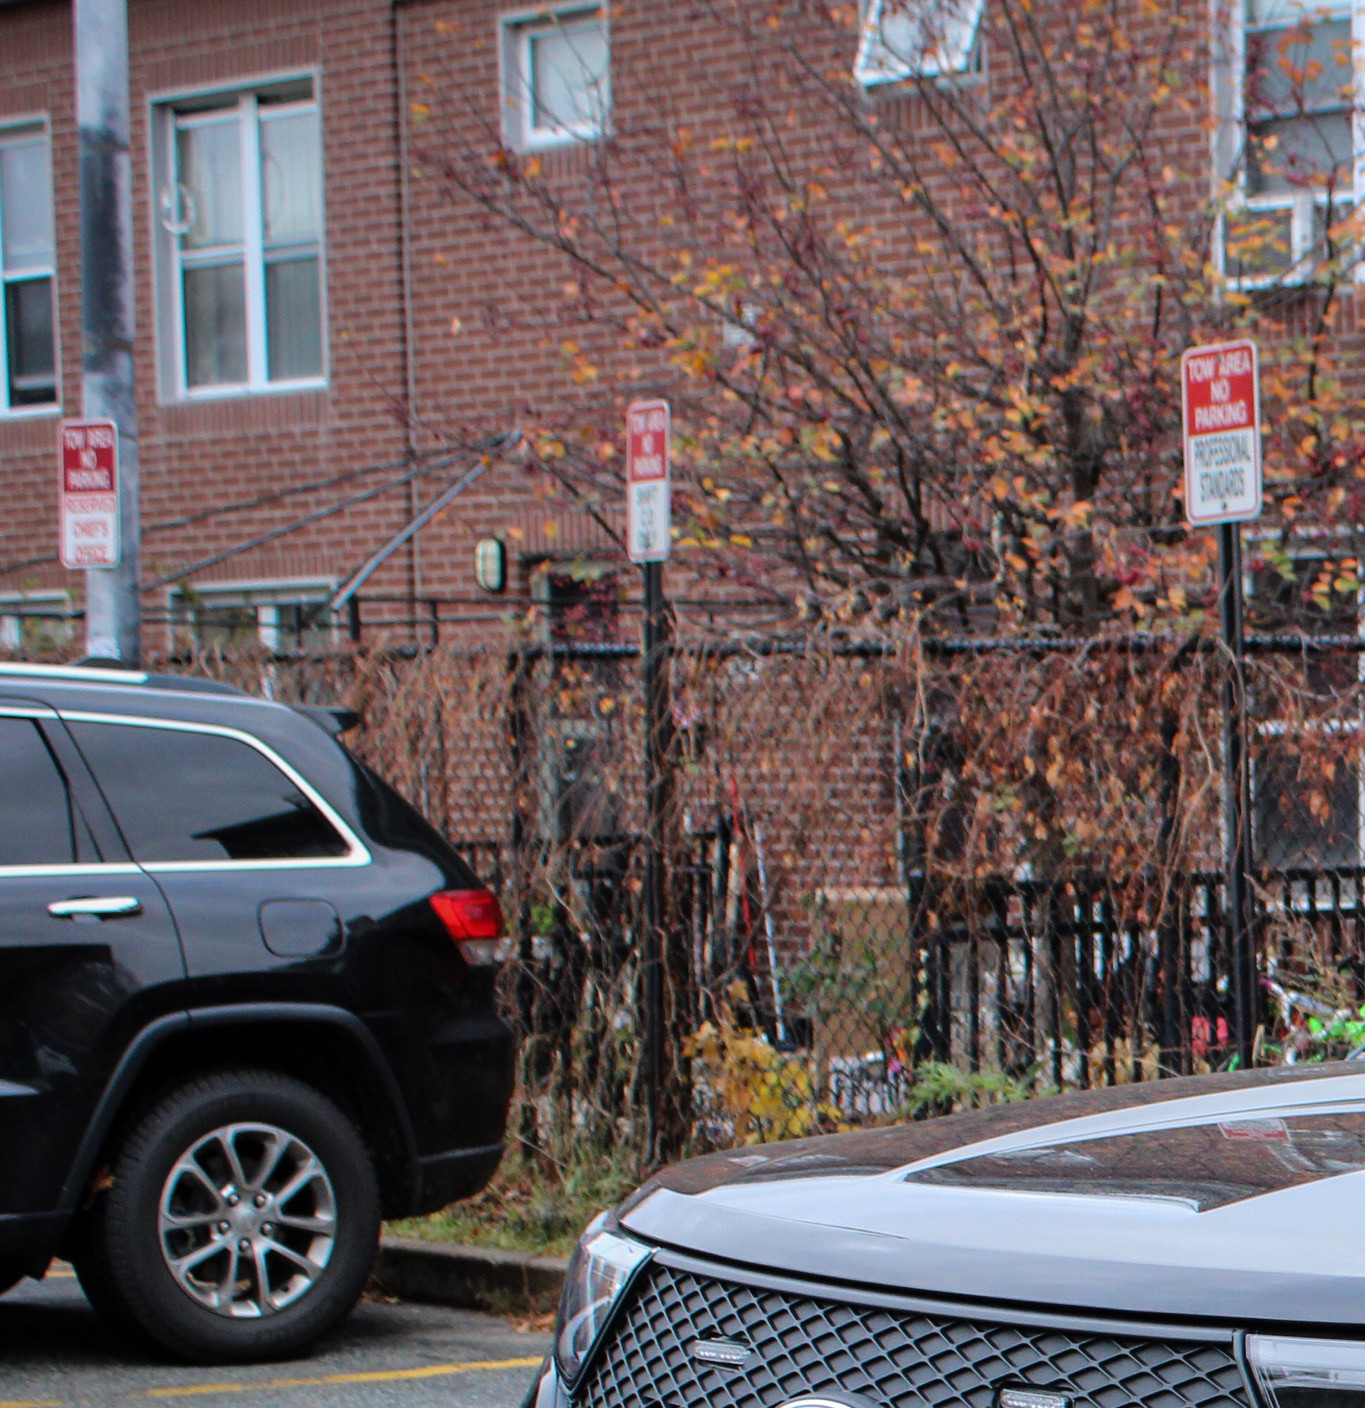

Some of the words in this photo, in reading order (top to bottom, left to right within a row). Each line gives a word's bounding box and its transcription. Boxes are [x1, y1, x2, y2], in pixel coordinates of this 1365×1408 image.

[1188, 357, 1215, 383] TOW
[1218, 350, 1251, 378] AREA
[1210, 378, 1232, 402] NO
[1194, 400, 1249, 432] PARKING
